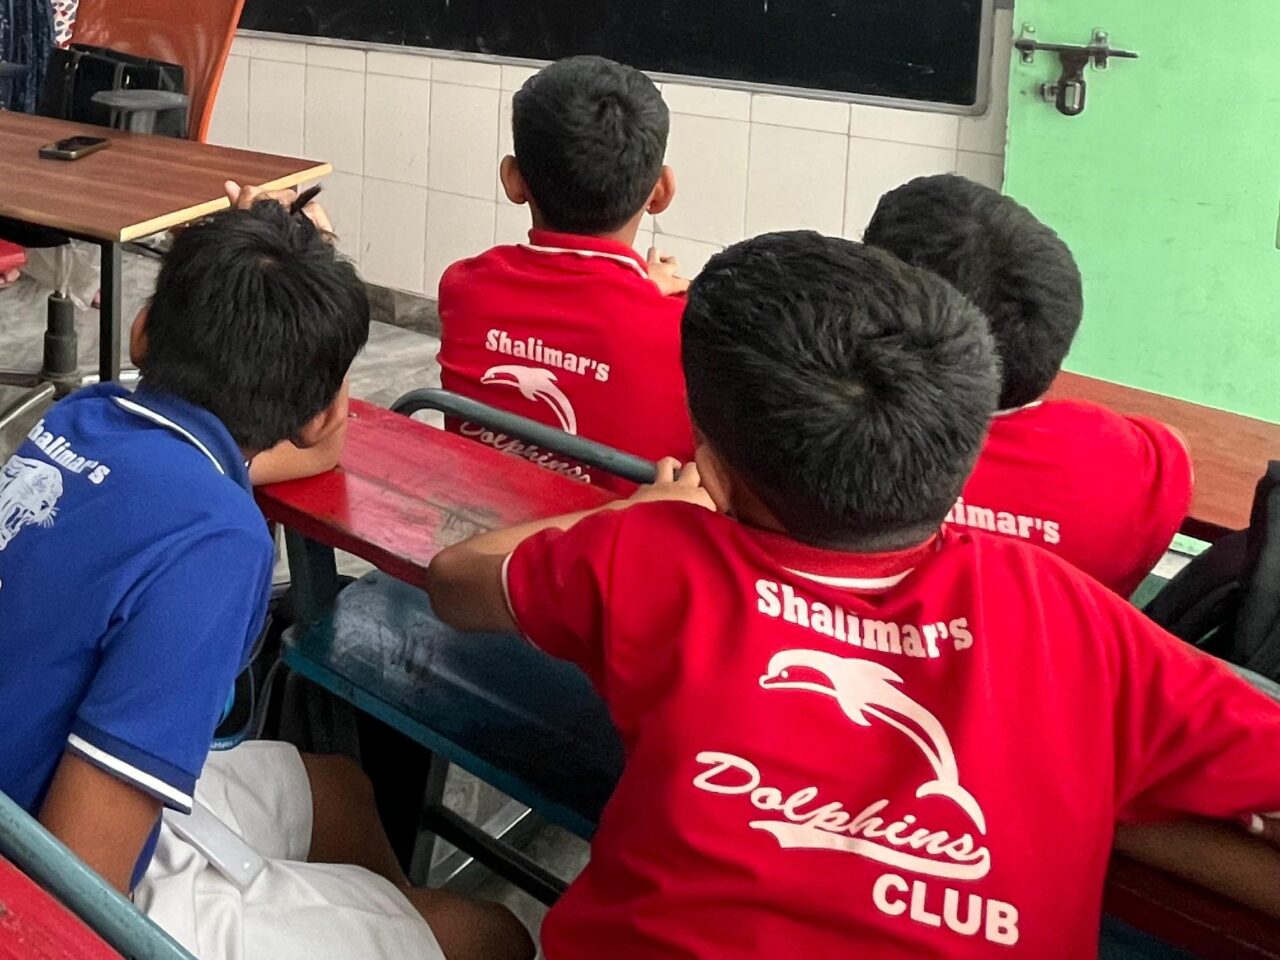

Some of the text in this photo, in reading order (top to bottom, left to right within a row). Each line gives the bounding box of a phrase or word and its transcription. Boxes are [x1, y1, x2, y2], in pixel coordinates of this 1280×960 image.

[485, 328, 610, 382] Shalimar's
[27, 418, 111, 484] halimar's
[755, 578, 973, 659] Shalimar's
[693, 751, 991, 861] Dolphins
[873, 873, 1020, 946] CLUB
